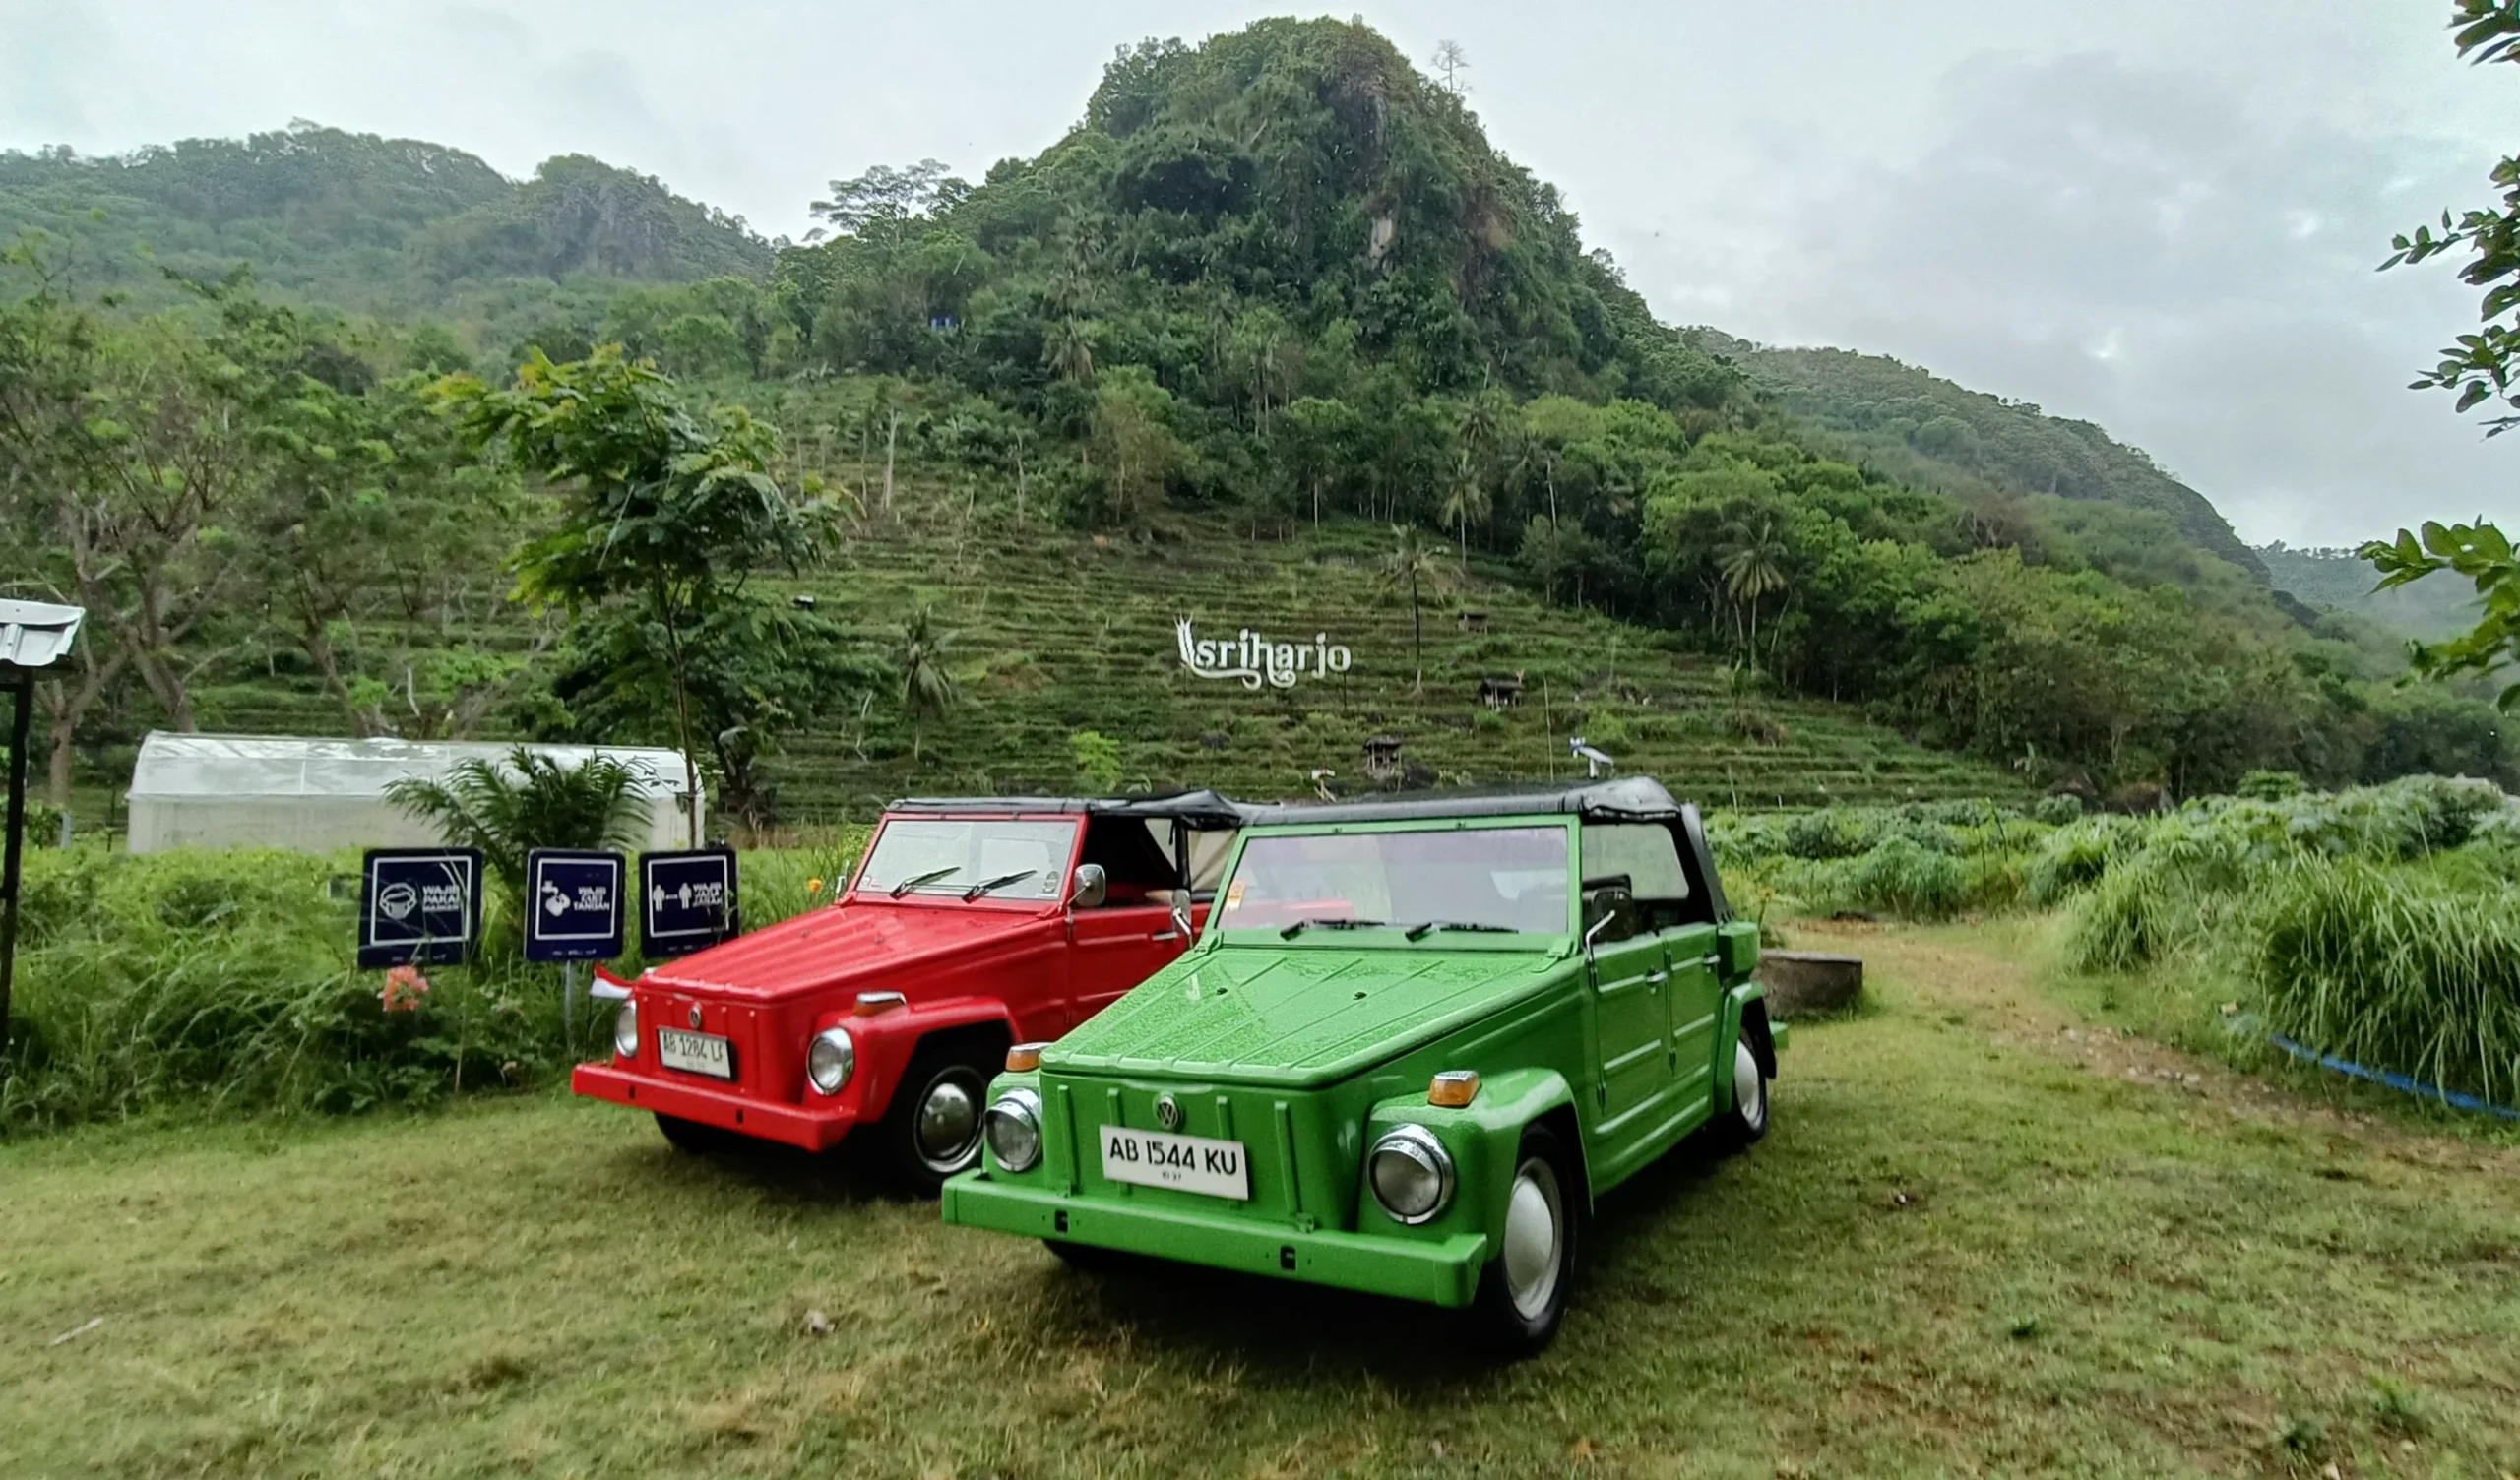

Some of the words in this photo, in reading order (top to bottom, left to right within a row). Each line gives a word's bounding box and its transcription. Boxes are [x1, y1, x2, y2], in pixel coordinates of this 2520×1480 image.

[1109, 1137, 1140, 1162] AB
[1146, 1140, 1196, 1171] 1544
[1204, 1147, 1237, 1176] KU
